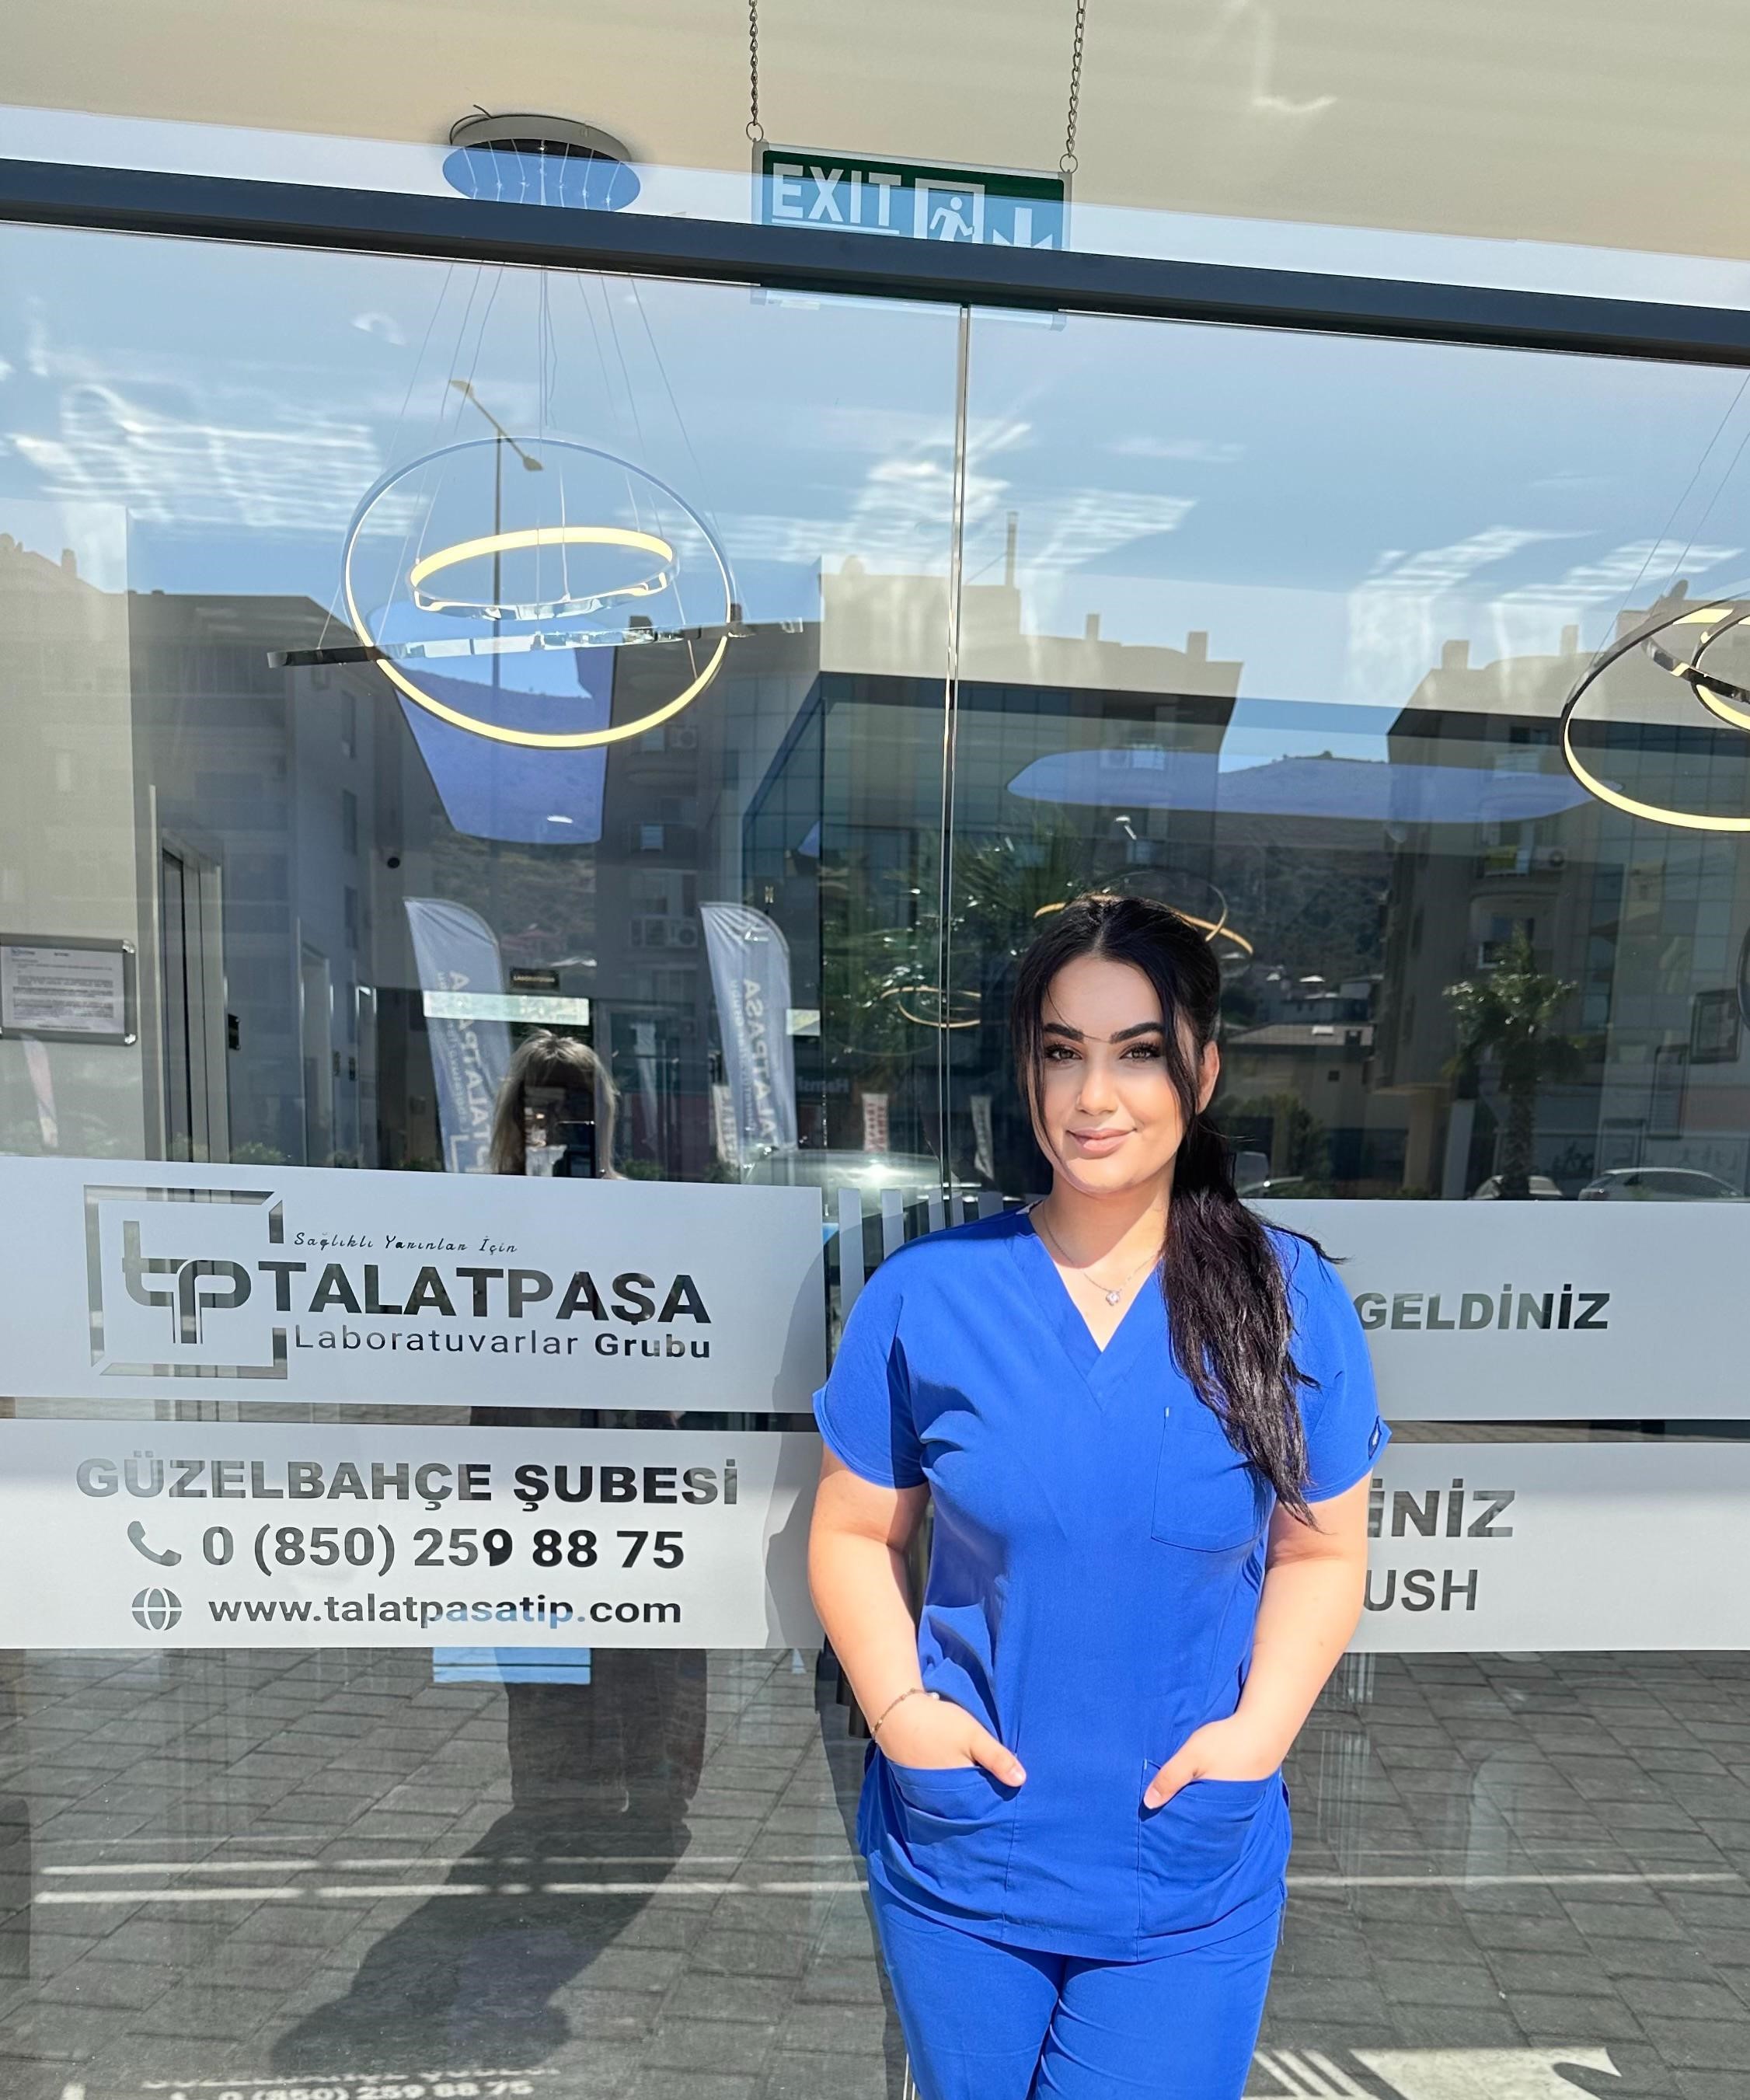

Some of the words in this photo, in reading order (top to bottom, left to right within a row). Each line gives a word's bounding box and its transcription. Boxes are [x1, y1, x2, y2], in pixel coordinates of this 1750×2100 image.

[772, 162, 901, 227] EXIT
[294, 1231, 374, 1251] Sağlıklı
[478, 1235, 518, 1255] İçin
[258, 1261, 712, 1326] TALATPAŞA
[1353, 1283, 1610, 1330] GELDİNİZ
[295, 1324, 579, 1355] Laboratuvarlar
[594, 1332, 710, 1359] Grubu
[76, 1449, 491, 1511] GÜZELBAHÇE
[513, 1458, 737, 1512] ŞUBESİ
[1368, 1478, 1516, 1538] İNİZ
[202, 1526, 234, 1566] 0
[254, 1523, 395, 1578] (850)
[413, 1527, 514, 1567] 259
[532, 1529, 598, 1568] 88
[616, 1530, 685, 1569] 75
[207, 1593, 682, 1630] www.talatpasatip.com
[1363, 1569, 1479, 1612] USH
